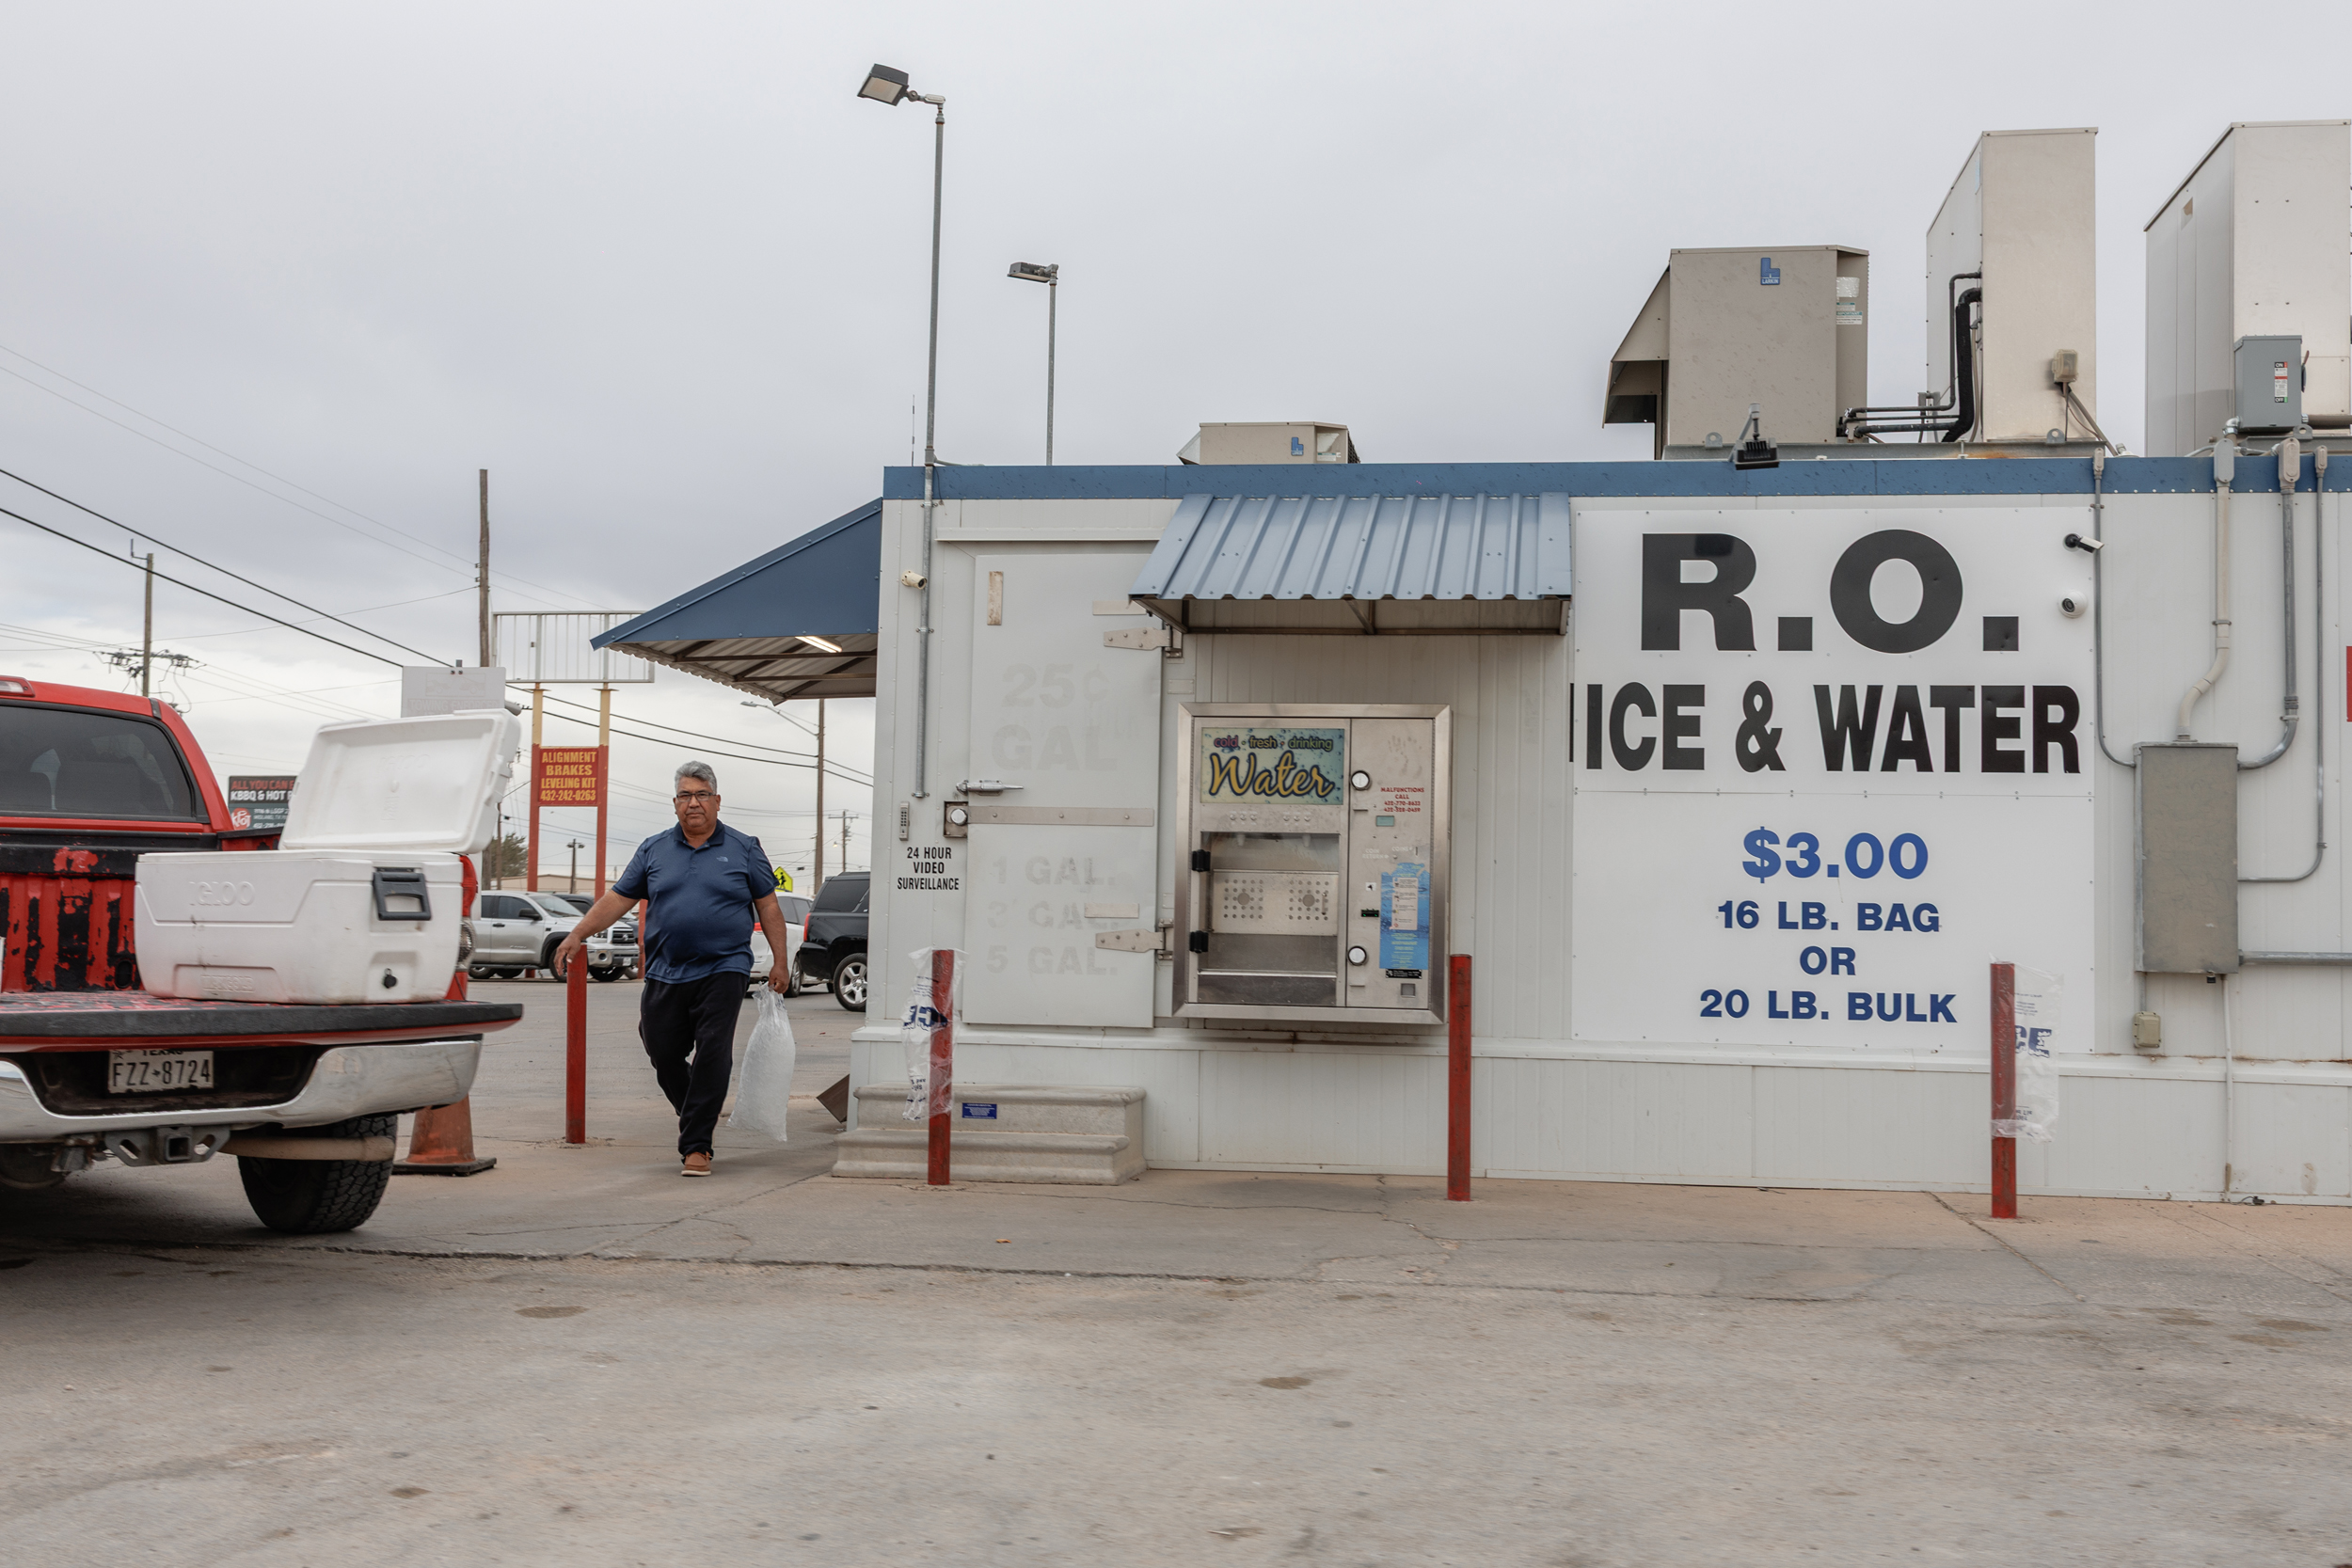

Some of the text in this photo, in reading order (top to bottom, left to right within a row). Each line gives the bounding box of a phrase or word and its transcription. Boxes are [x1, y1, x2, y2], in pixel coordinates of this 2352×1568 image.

[1641, 529, 2019, 654] R.O.
[1586, 680, 2081, 774] ICE & WATER
[991, 723, 1119, 771] GAL
[1214, 735, 1334, 752] cold fresh drinking
[541, 752, 596, 763] ALIGNMENT
[546, 765, 593, 776] BRAKES
[230, 780, 248, 790] ALL
[249, 780, 268, 790] YOU
[268, 780, 288, 790] CAN
[541, 777, 596, 789] LEVELING KIT
[1209, 750, 1336, 798] Water
[230, 790, 257, 801] KBBQ
[257, 790, 265, 800] &
[265, 790, 287, 800] HOT
[540, 789, 596, 801] 432-242-0263
[906, 847, 952, 859] 24 HOUR
[1742, 826, 1929, 884] $3.00
[913, 862, 945, 874] VIDEO
[993, 855, 1008, 884] 1
[898, 877, 960, 890] SURVEILLANCE
[1718, 900, 1939, 933] 16 LB. BAG
[986, 945, 1118, 975] 5 GAL.
[1800, 945, 1856, 975] OR
[1700, 989, 1958, 1023] 20 LB. BULK
[162, 1059, 211, 1085] 8724
